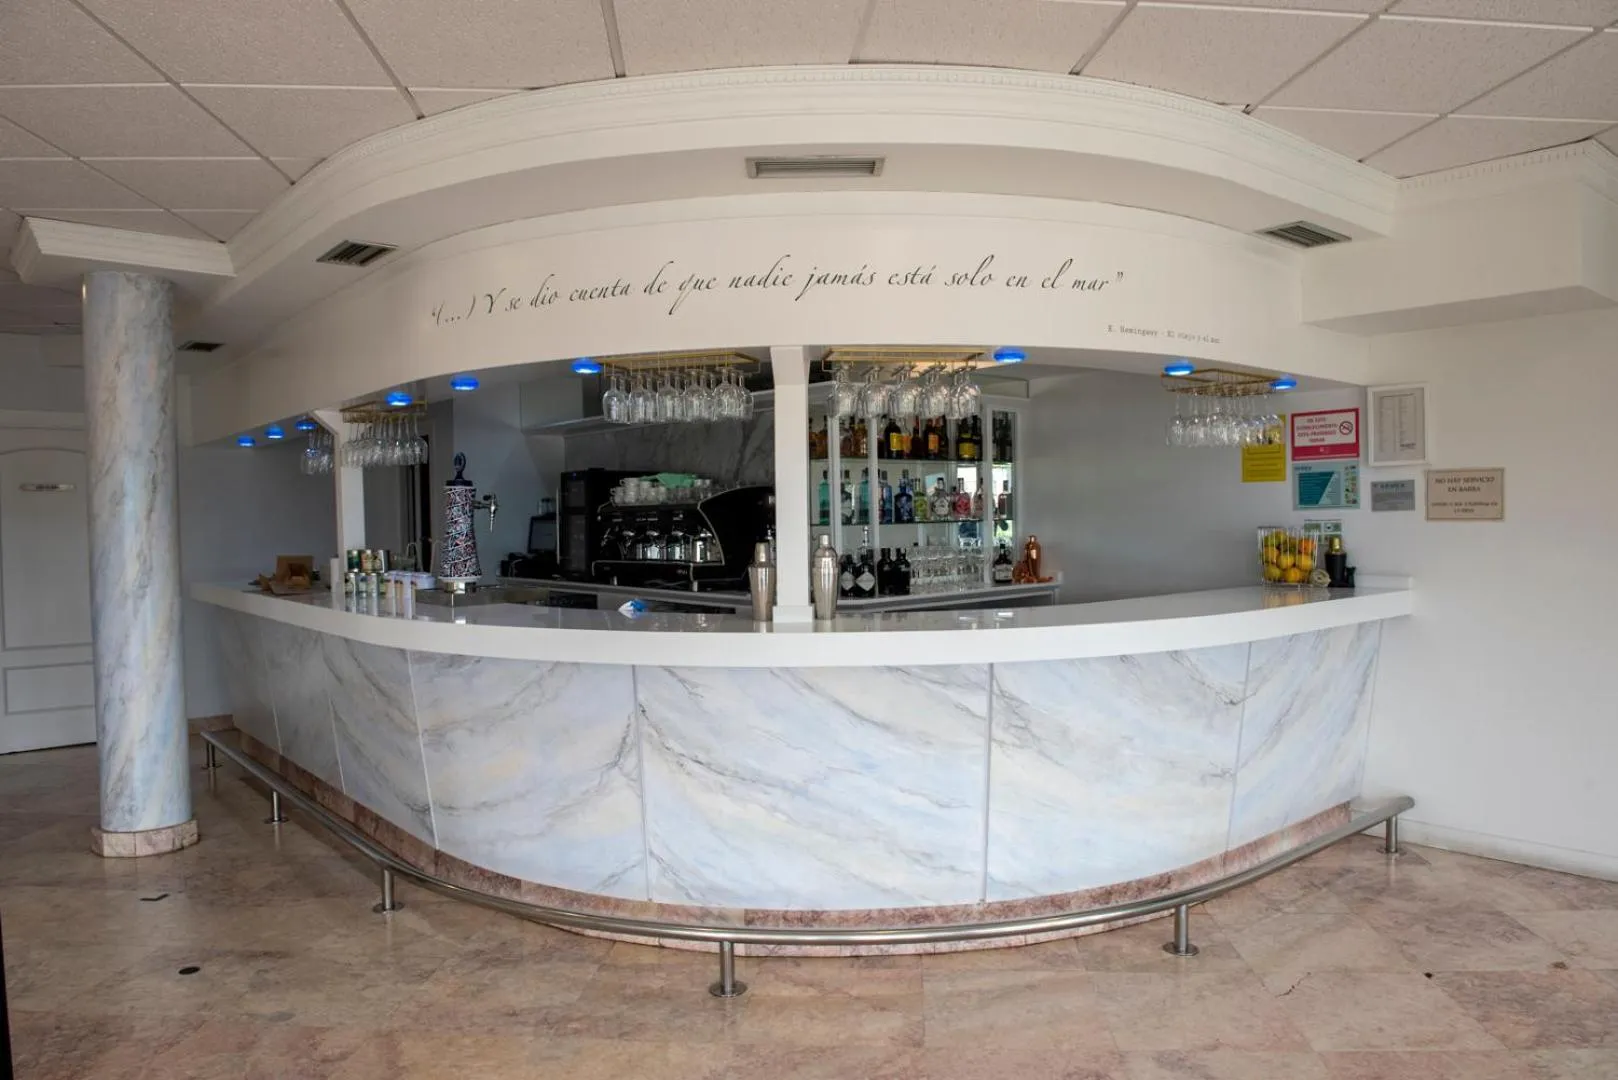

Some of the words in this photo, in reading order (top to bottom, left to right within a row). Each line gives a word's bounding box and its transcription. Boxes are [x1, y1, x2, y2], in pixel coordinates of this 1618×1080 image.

[504, 297, 521, 311] se
[528, 273, 559, 309] dio
[568, 278, 631, 302] cuenta
[643, 260, 674, 295] de
[668, 273, 717, 316] que
[728, 254, 794, 289] nadie
[794, 264, 877, 302] jamás
[887, 265, 937, 287] está
[944, 254, 995, 288] solo
[1005, 275, 1028, 289] en
[1040, 258, 1072, 290] el
